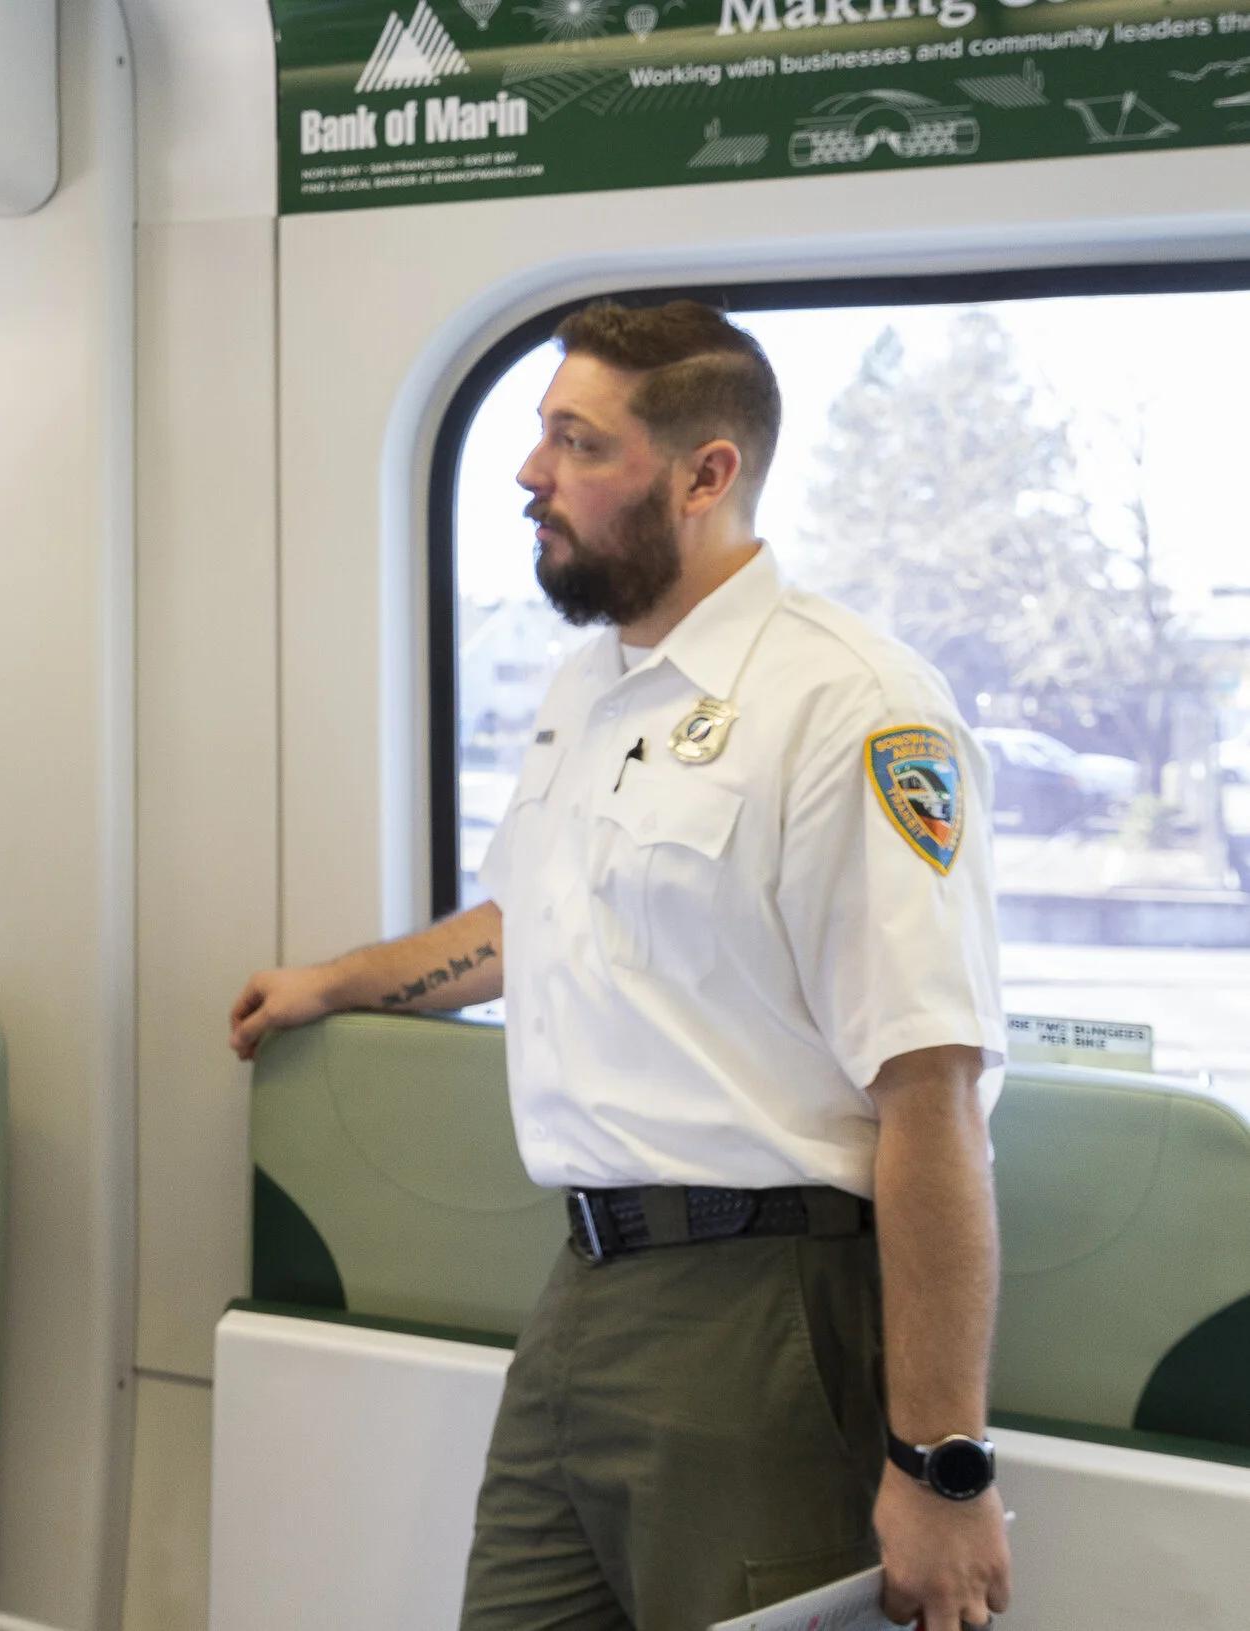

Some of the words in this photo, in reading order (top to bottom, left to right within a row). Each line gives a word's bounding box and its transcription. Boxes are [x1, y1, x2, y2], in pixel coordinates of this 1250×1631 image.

[629, 63, 722, 88] Working
[725, 55, 776, 79] with
[780, 47, 912, 75] businesses
[916, 37, 964, 62] and
[968, 24, 1110, 57] community
[1114, 16, 1213, 43] leaders
[301, 104, 378, 155] Bank
[384, 99, 419, 147] of
[425, 91, 529, 144] Marin
[301, 166, 338, 180] NORTH
[340, 164, 362, 177] BAY
[370, 162, 392, 175] SAN
[393, 156, 458, 173] FRANCISCO
[493, 151, 519, 165] BAY
[337, 178, 372, 193] LOCAL
